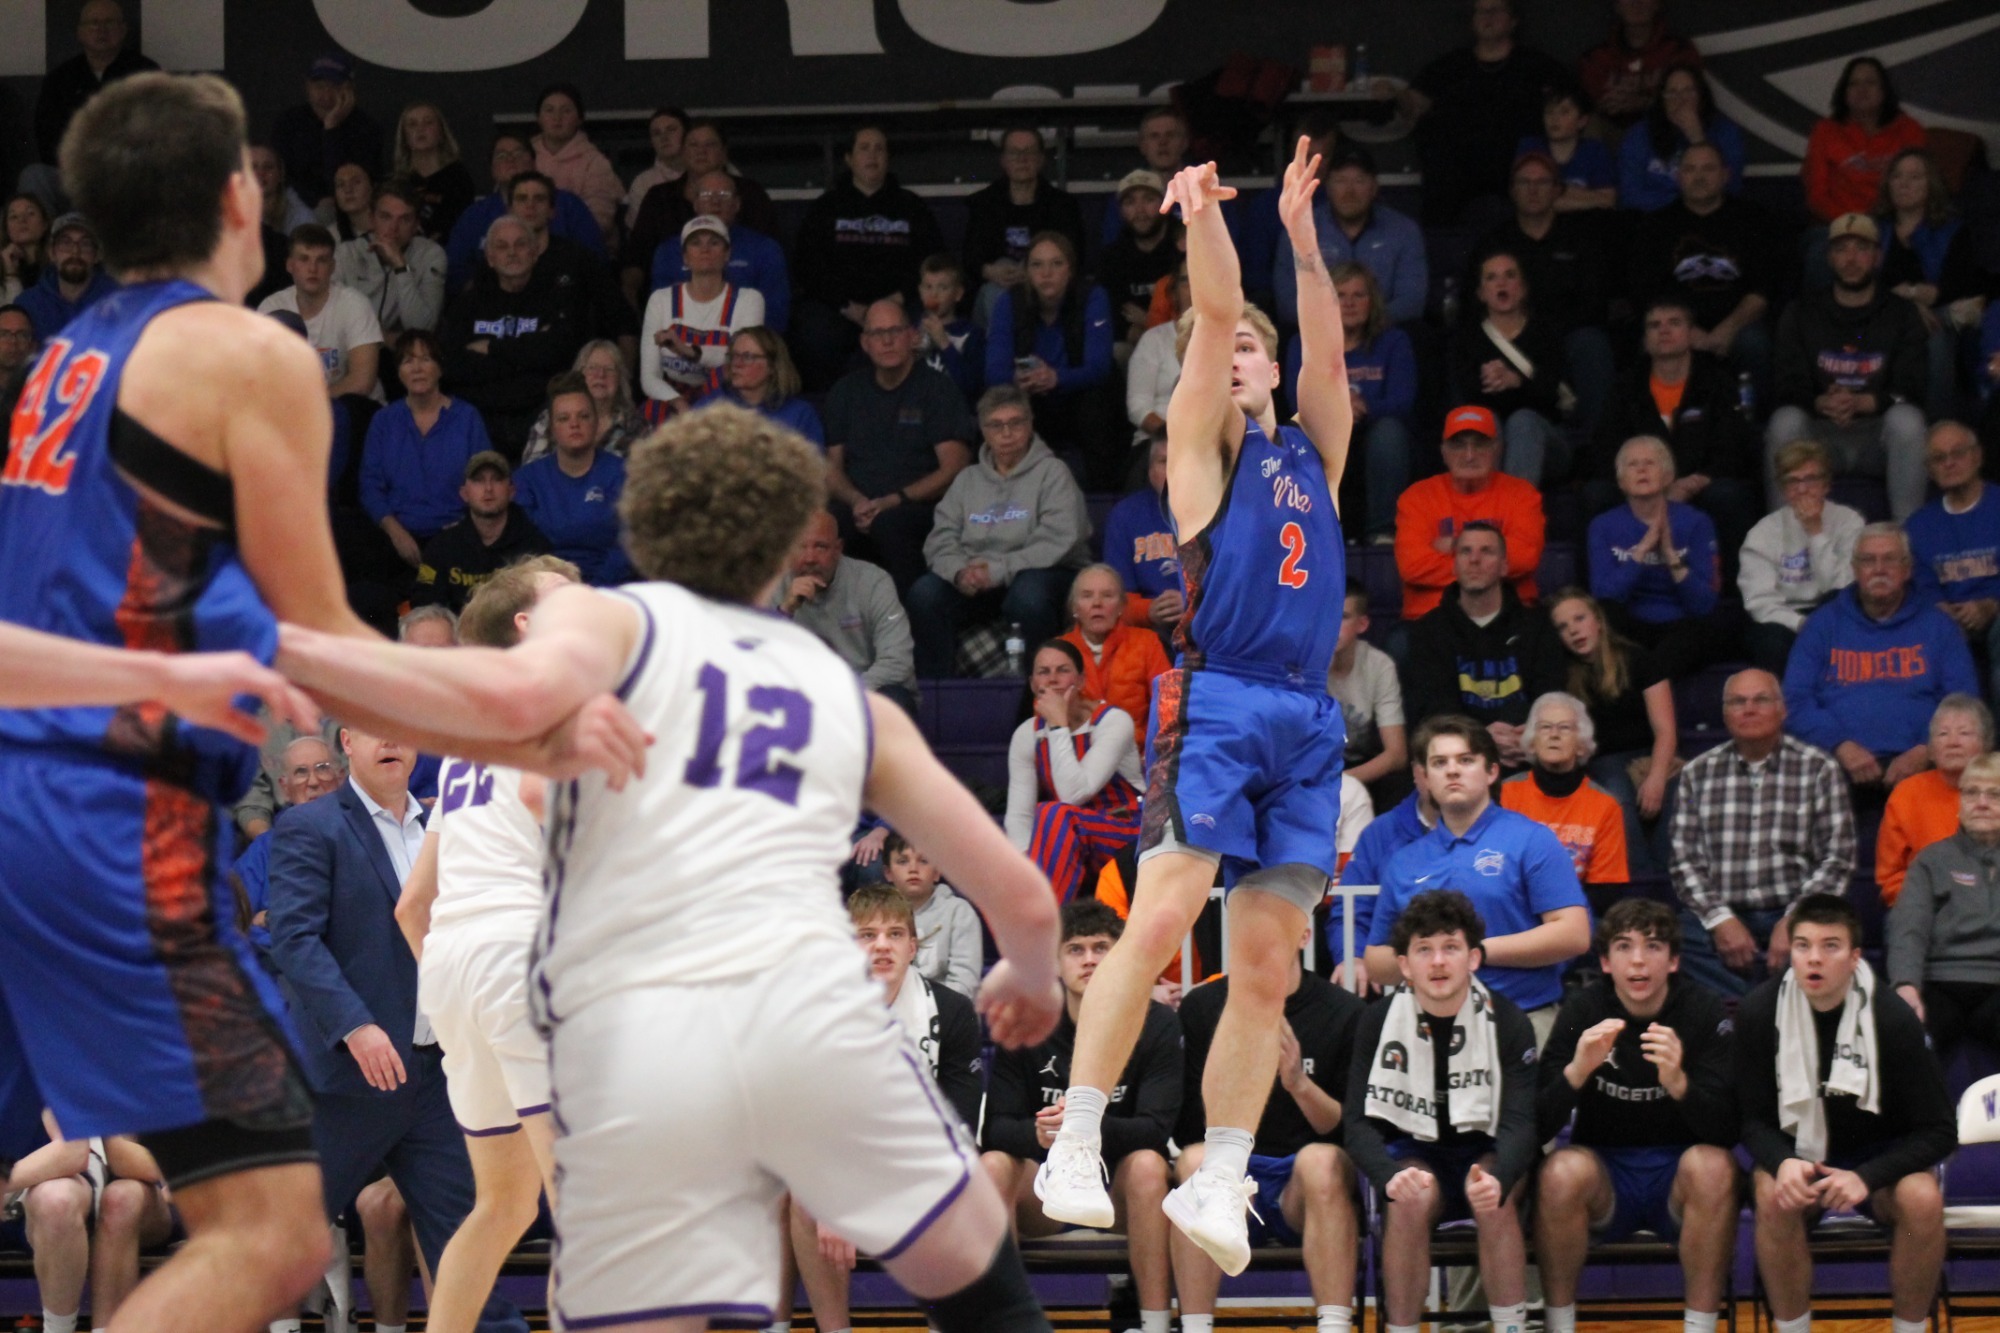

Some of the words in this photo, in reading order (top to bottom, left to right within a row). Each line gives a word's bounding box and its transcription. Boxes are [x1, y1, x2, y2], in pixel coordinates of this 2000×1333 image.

[0, 337, 110, 496] 42
[1261, 456, 1282, 478] The
[1279, 521, 1309, 589] 2
[1826, 643, 1927, 686] PIONEERS
[682, 660, 815, 807] 12
[442, 757, 494, 818] 22
